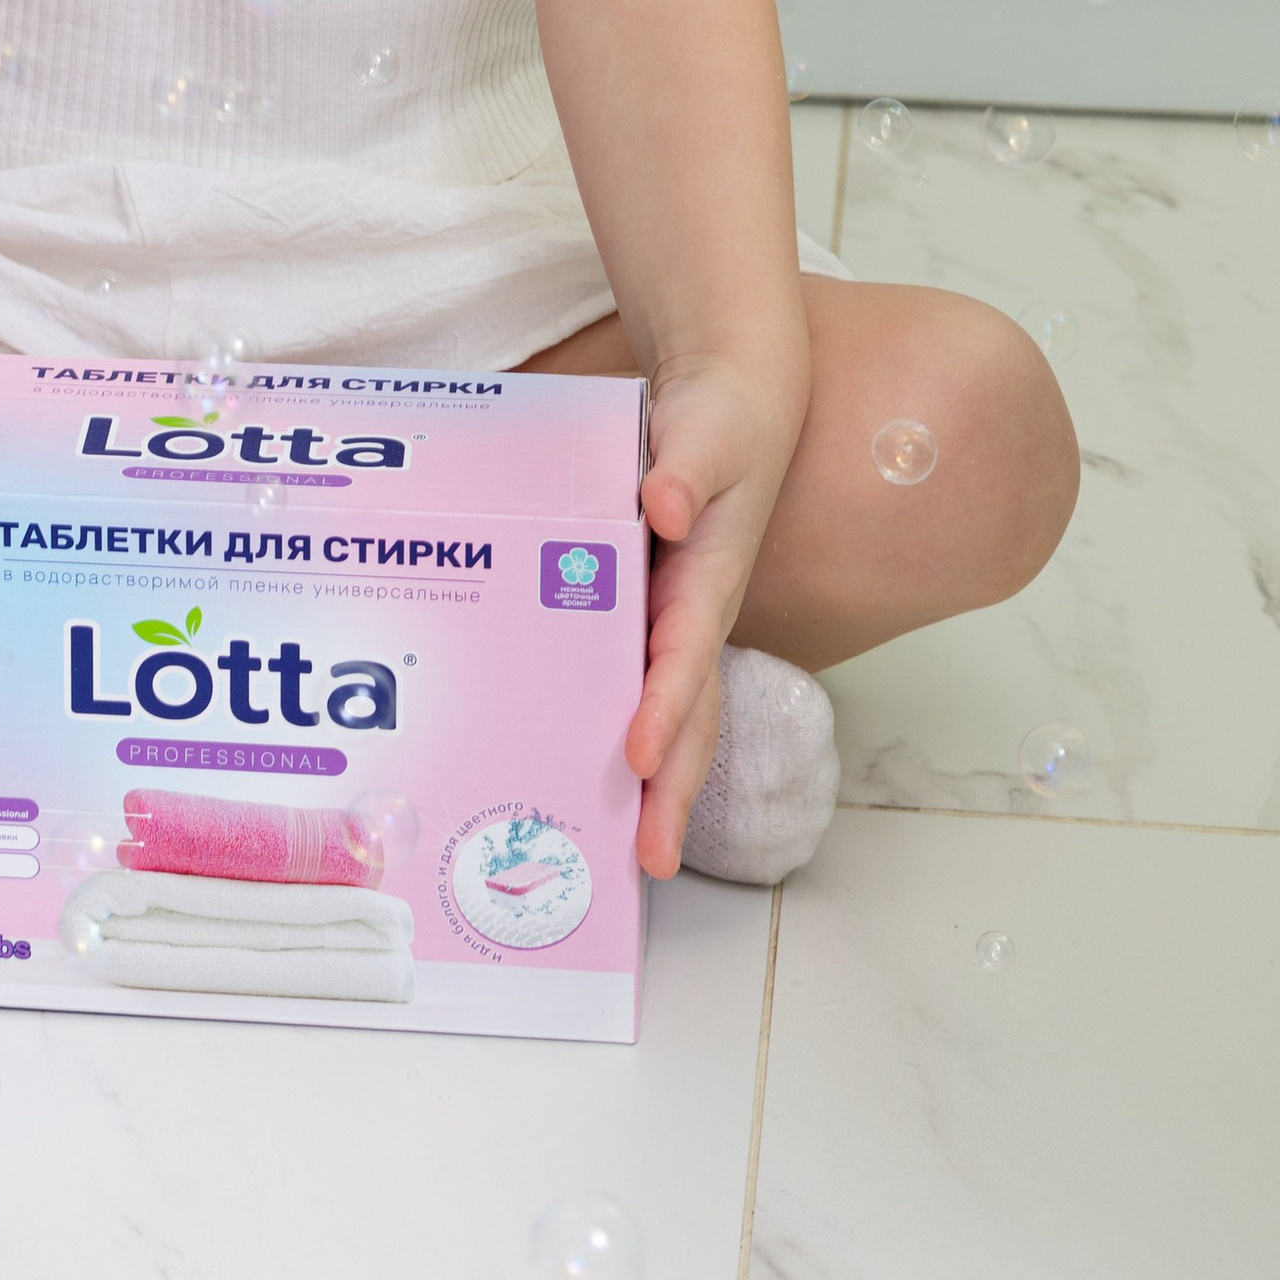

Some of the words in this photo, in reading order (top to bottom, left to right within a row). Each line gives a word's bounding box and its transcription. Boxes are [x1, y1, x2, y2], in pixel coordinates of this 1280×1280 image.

[31, 366, 238, 387] ТАБЛЕТКИ
[246, 374, 332, 390] ДЛЯ
[341, 377, 503, 395] СТИРКИ
[249, 395, 321, 405] пленке
[330, 397, 491, 410] универсальные
[81, 416, 406, 469] Lotta
[134, 468, 333, 486] PROFESSIONAL
[223, 531, 312, 564] ДЛЯ
[322, 535, 493, 570] СТИРКИ
[3, 569, 13, 581] в
[23, 569, 219, 591] водорастворимой
[228, 578, 304, 595] пленке
[313, 583, 481, 603] универсальные
[70, 624, 397, 731] Lotta
[130, 744, 328, 771] PROFESSIONAL
[456, 801, 524, 837] цветного
[440, 836, 459, 865] для
[463, 933, 492, 957] для
